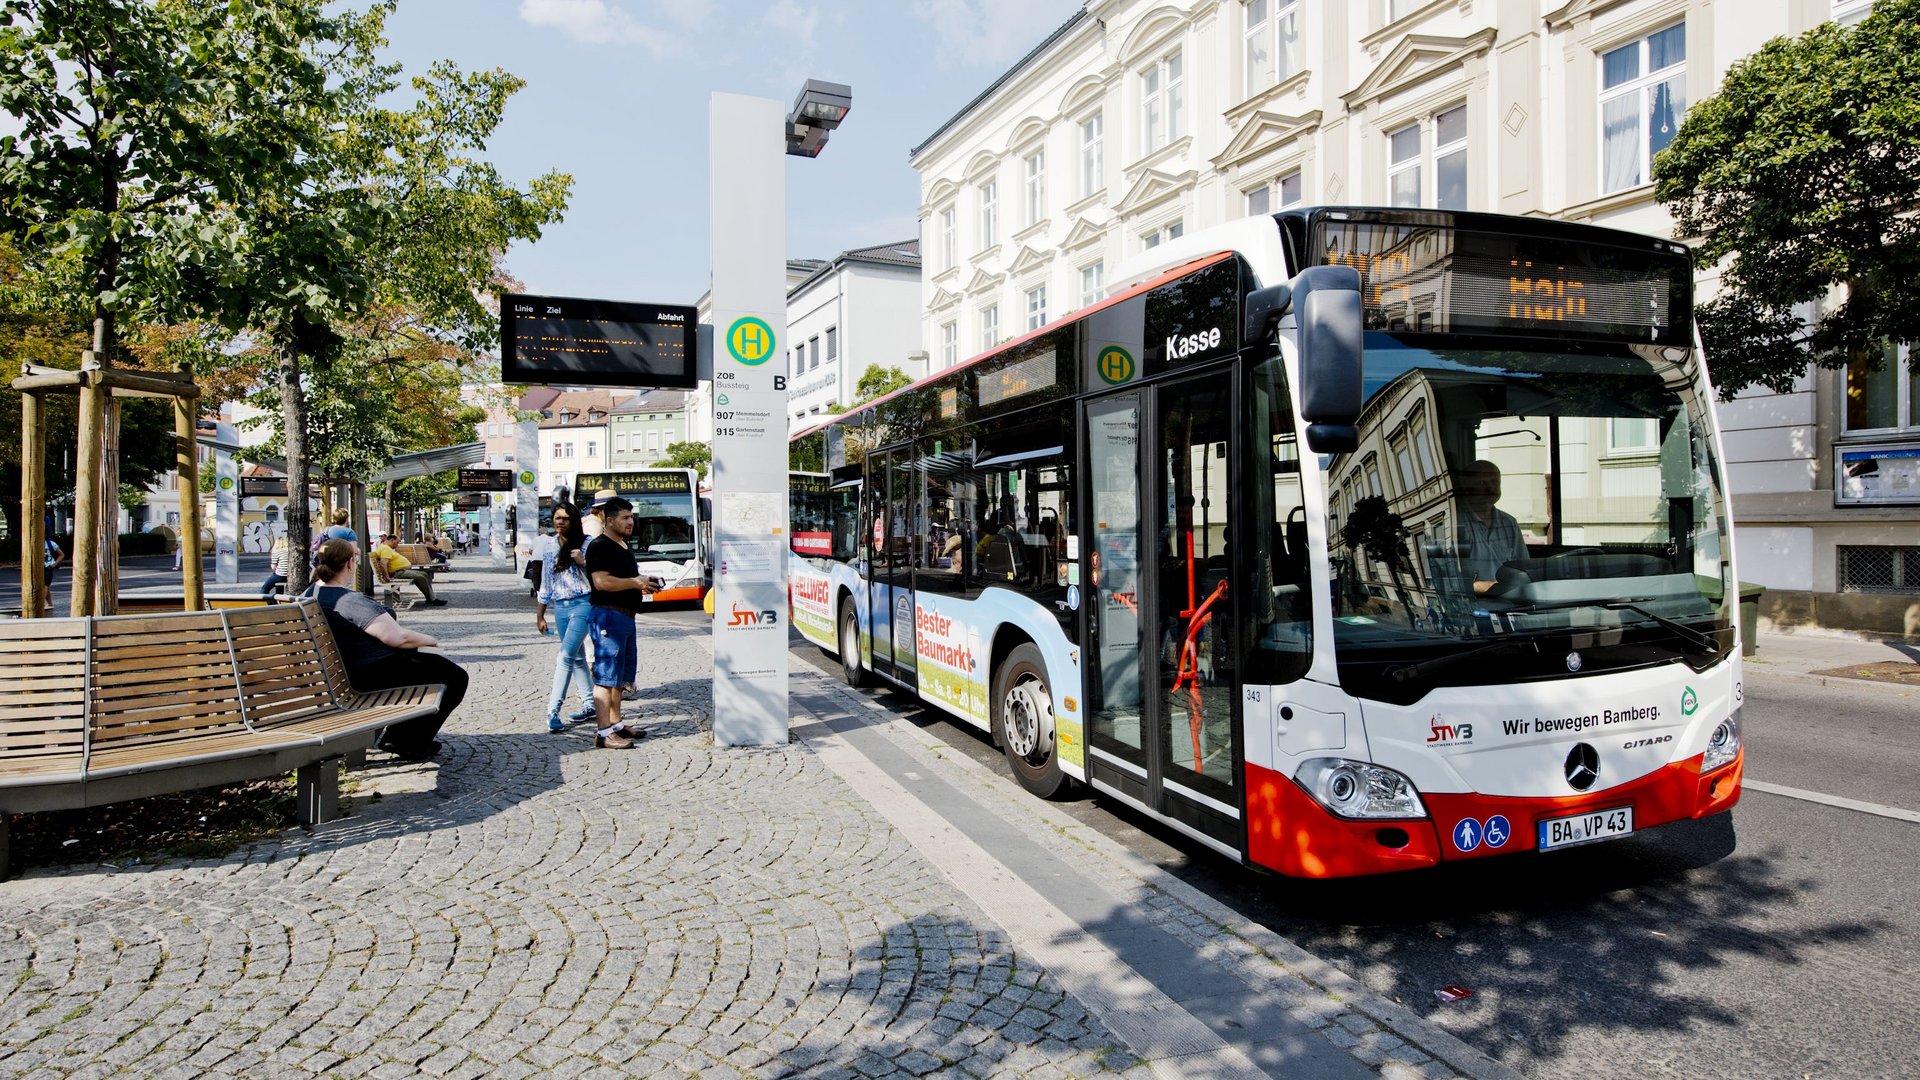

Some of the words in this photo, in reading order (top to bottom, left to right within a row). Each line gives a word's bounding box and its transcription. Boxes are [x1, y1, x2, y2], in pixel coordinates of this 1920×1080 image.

[515, 304, 534, 313] Linie
[547, 306, 562, 315] Ziel
[657, 312, 685, 322] Abfahrt
[1166, 327, 1221, 361] Kasse
[716, 372, 735, 380] ZOB
[716, 381, 750, 391] Bussteig
[773, 375, 787, 391] B
[716, 411, 735, 420] 907
[716, 427, 735, 436] 915
[611, 474, 682, 484] Kastanienstr.
[647, 480, 686, 489] Stadion
[795, 575, 829, 605] HELLWEG
[916, 606, 951, 638] Bester
[917, 631, 973, 672] Baumarkt
[959, 691, 969, 707] 20
[971, 693, 986, 716] Uhr
[1246, 689, 1261, 702] 343
[1502, 719, 1530, 736] Wir
[1535, 714, 1599, 733] bewegen
[1603, 706, 1661, 724] Bamberg.
[1622, 735, 1674, 749] CITARO
[1552, 820, 1573, 843] BA
[1584, 815, 1603, 837] VP
[1607, 811, 1626, 832] 43
